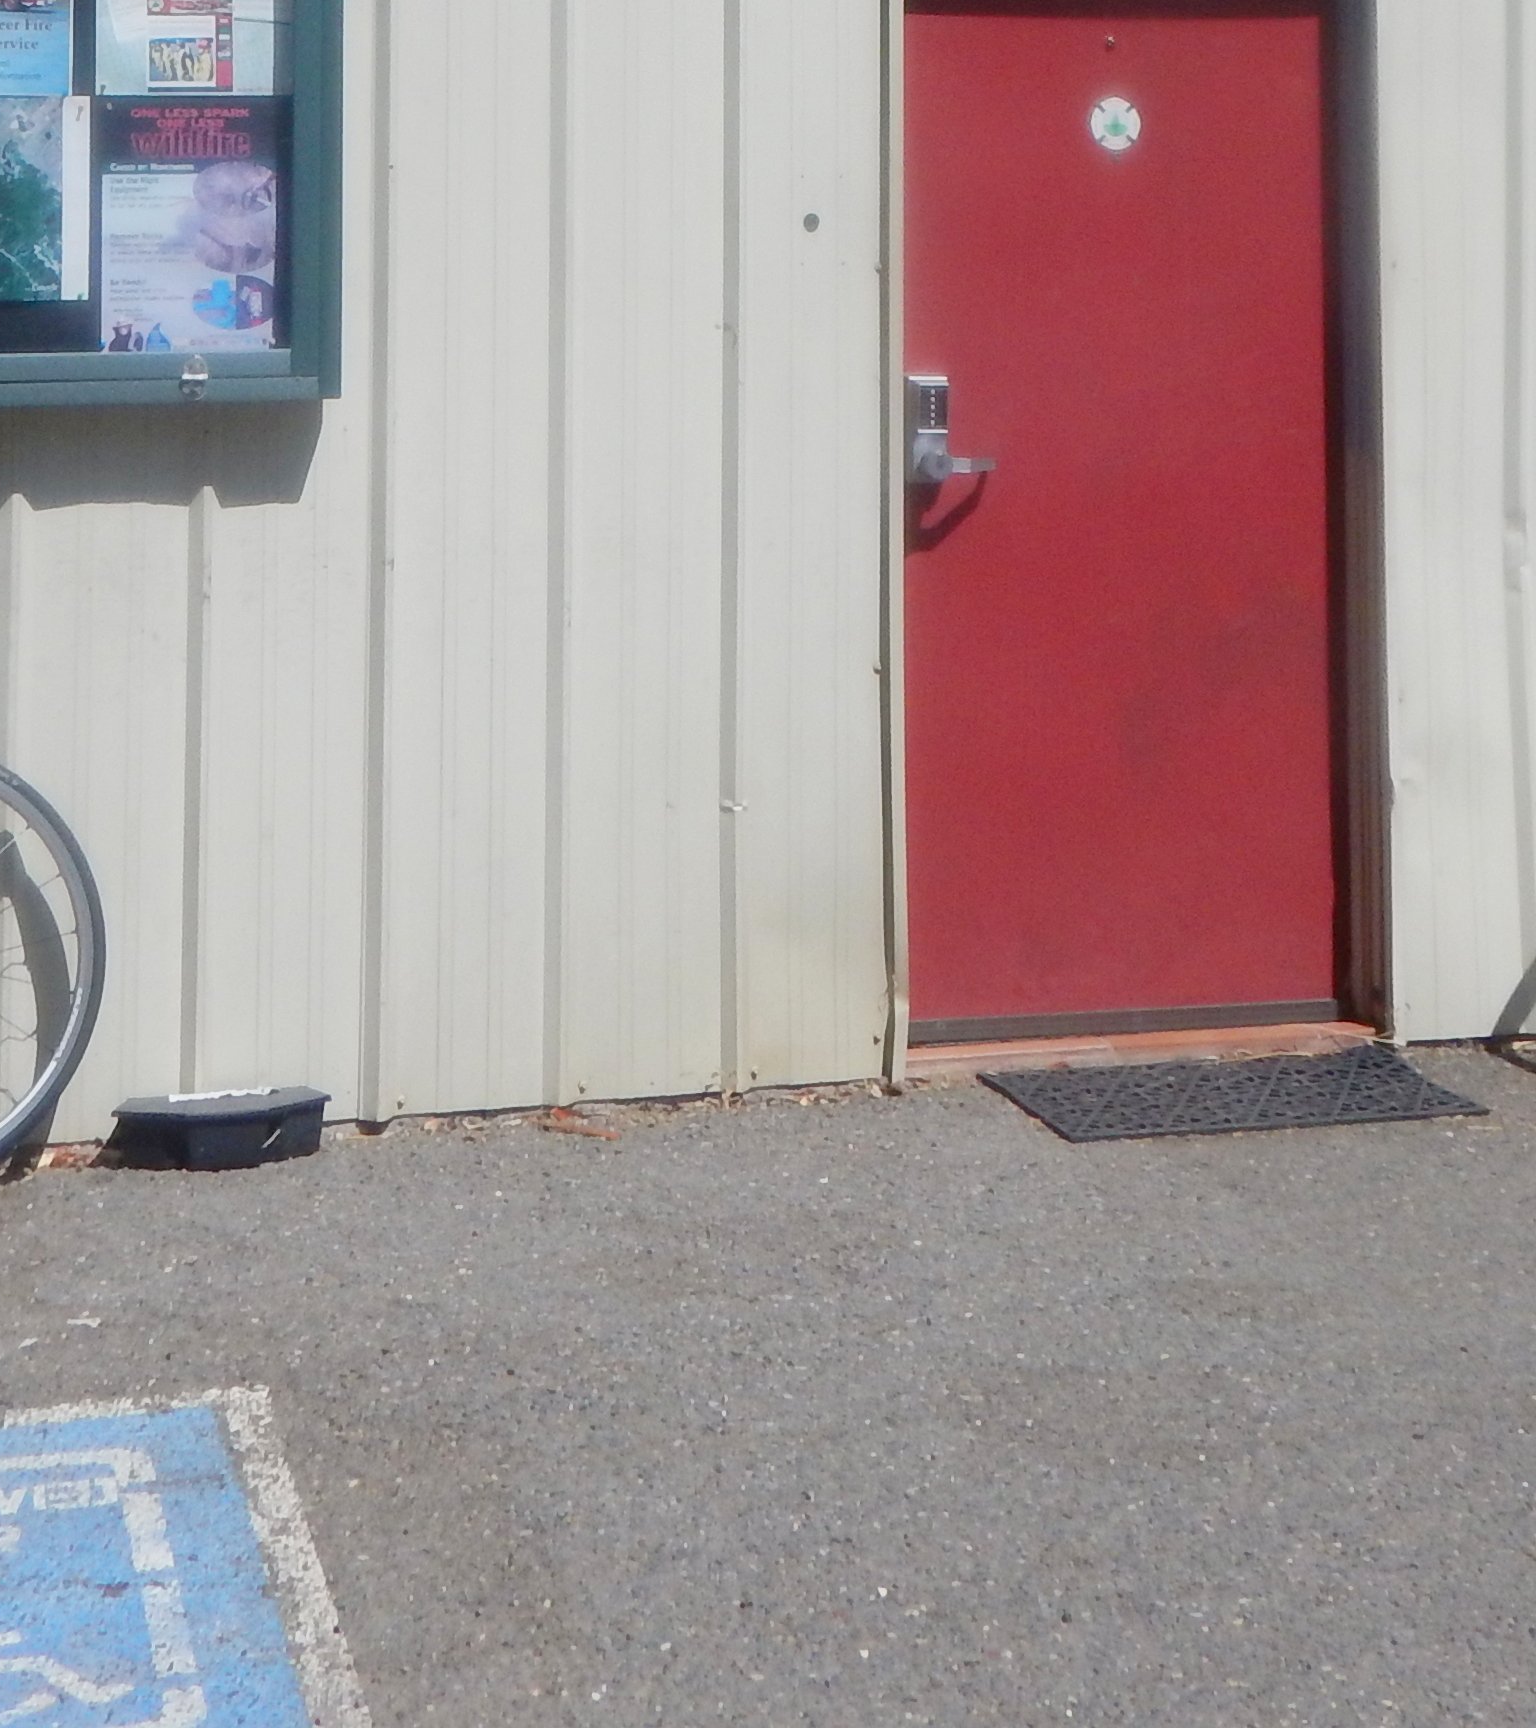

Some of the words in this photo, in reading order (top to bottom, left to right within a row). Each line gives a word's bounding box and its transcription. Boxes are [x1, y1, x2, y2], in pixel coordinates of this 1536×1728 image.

[24, 18, 53, 32] Fire
[130, 107, 161, 118] ONE
[164, 107, 199, 118] LESS
[203, 107, 251, 118] SPARK
[156, 118, 186, 128] ONE
[190, 118, 225, 128] LESS
[130, 125, 252, 158] wildfire
